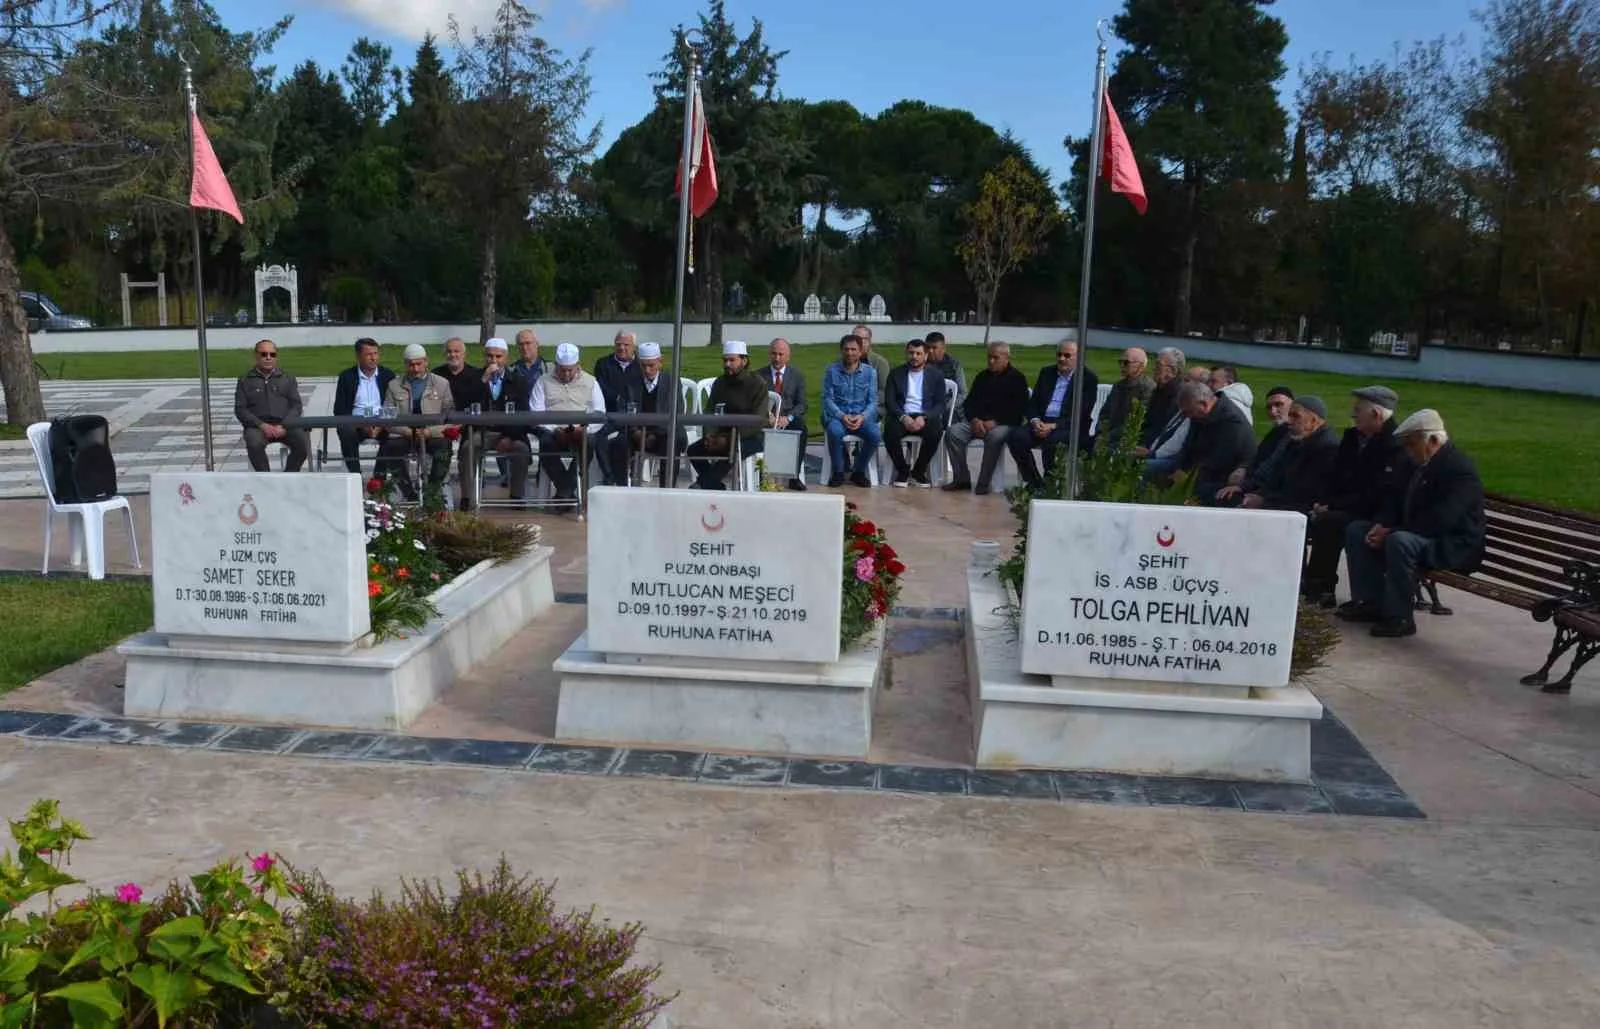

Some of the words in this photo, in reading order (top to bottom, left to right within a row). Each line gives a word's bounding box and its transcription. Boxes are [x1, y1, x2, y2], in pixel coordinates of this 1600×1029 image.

[689, 542, 735, 556] ŞEHİT
[1138, 553, 1190, 571] ŞEHİT
[203, 568, 244, 584] SAMET
[632, 582, 724, 599] MUTLUCAN
[729, 584, 794, 604] MEŞECİ
[204, 607, 248, 620] RUHUNA
[260, 609, 296, 624] FATİHA
[1070, 597, 1141, 622] TOLGA
[1147, 600, 1249, 628] PEHLİVAN
[648, 624, 715, 640] RUHUNA
[719, 627, 773, 643] FATİHA
[1088, 650, 1160, 668] RUHUNA
[1164, 654, 1222, 671] FATİHA
